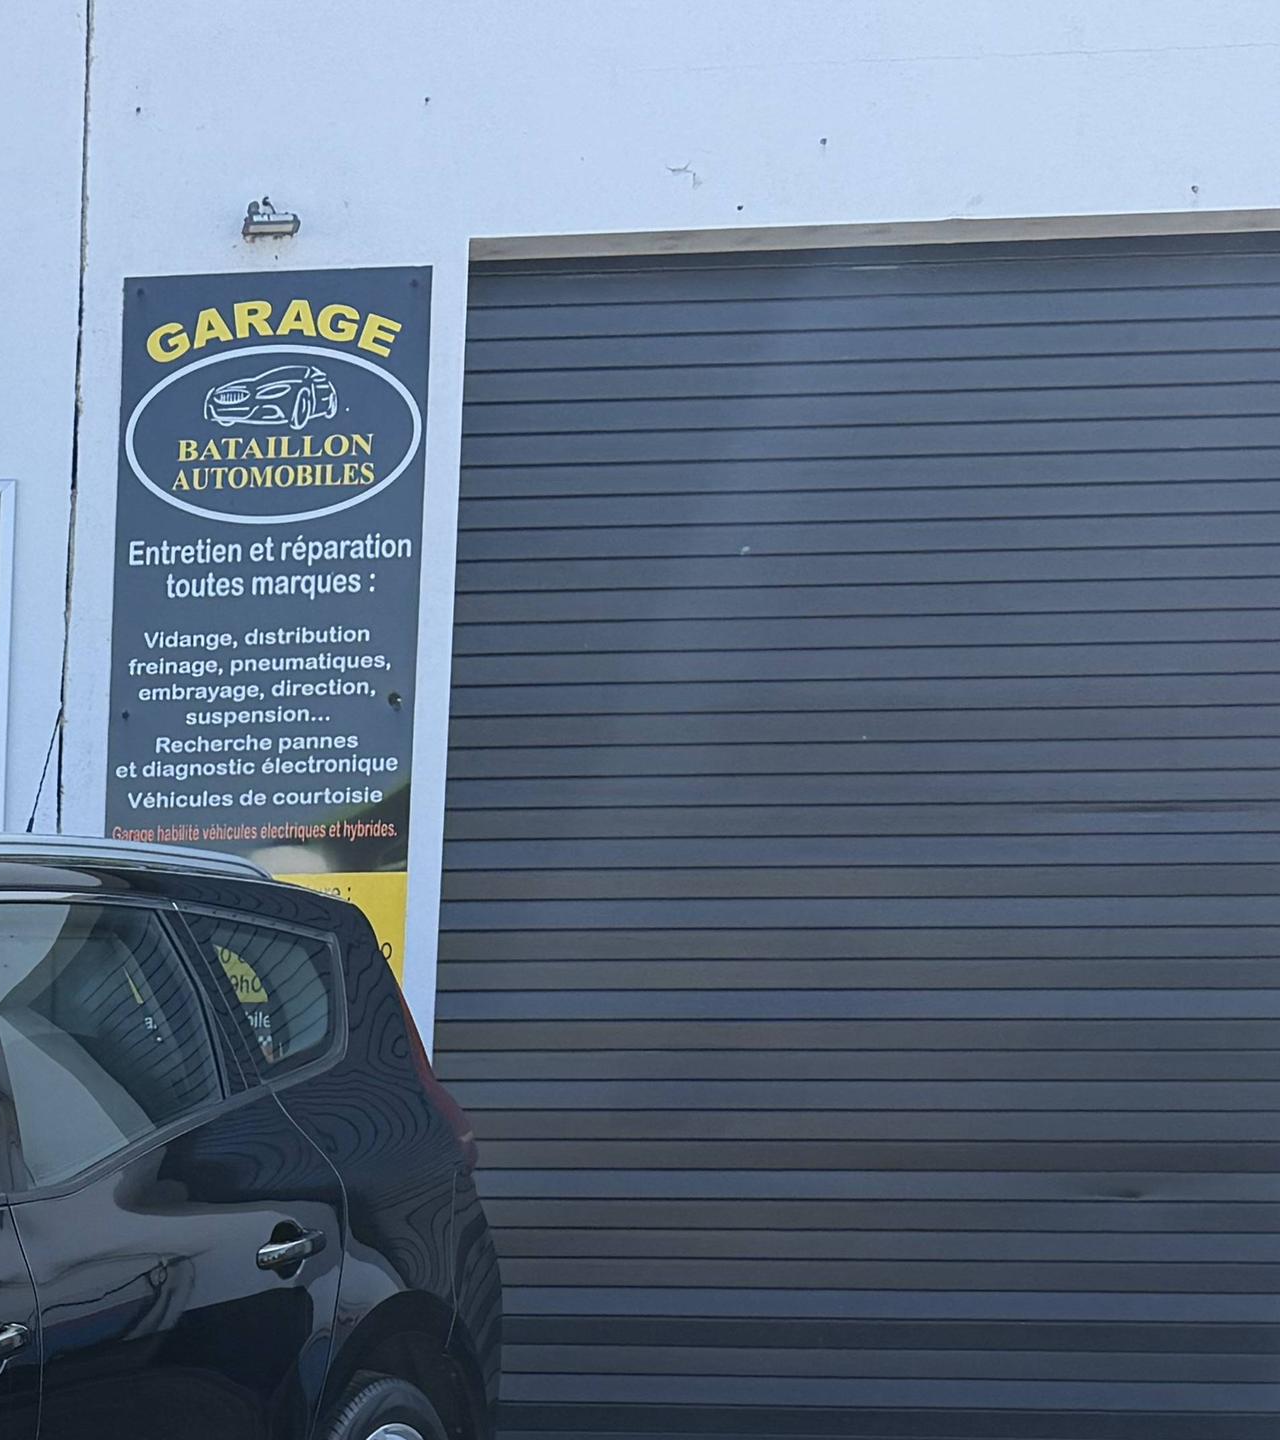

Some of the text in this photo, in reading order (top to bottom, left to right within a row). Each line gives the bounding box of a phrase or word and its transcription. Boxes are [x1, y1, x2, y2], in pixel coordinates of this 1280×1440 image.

[146, 299, 402, 363] GARAGE
[177, 433, 375, 462] BATAILLON
[171, 462, 375, 491] AUTOMOBILES
[129, 533, 412, 566] Entretien et réparation
[166, 572, 244, 599] toutes
[252, 571, 361, 600] marques
[143, 626, 370, 650] Vidange, distribution
[128, 652, 391, 677] freinage, pneumatiques,
[138, 678, 377, 704] embrayage, direction,
[185, 706, 330, 727] suspension...
[155, 735, 359, 755] Recherche pannes
[115, 754, 399, 780] et diagnostic électronique
[128, 786, 383, 809] Véhicules de courtoisie
[112, 826, 154, 842] Garage
[202, 823, 258, 840] véhicules
[328, 820, 341, 838] et
